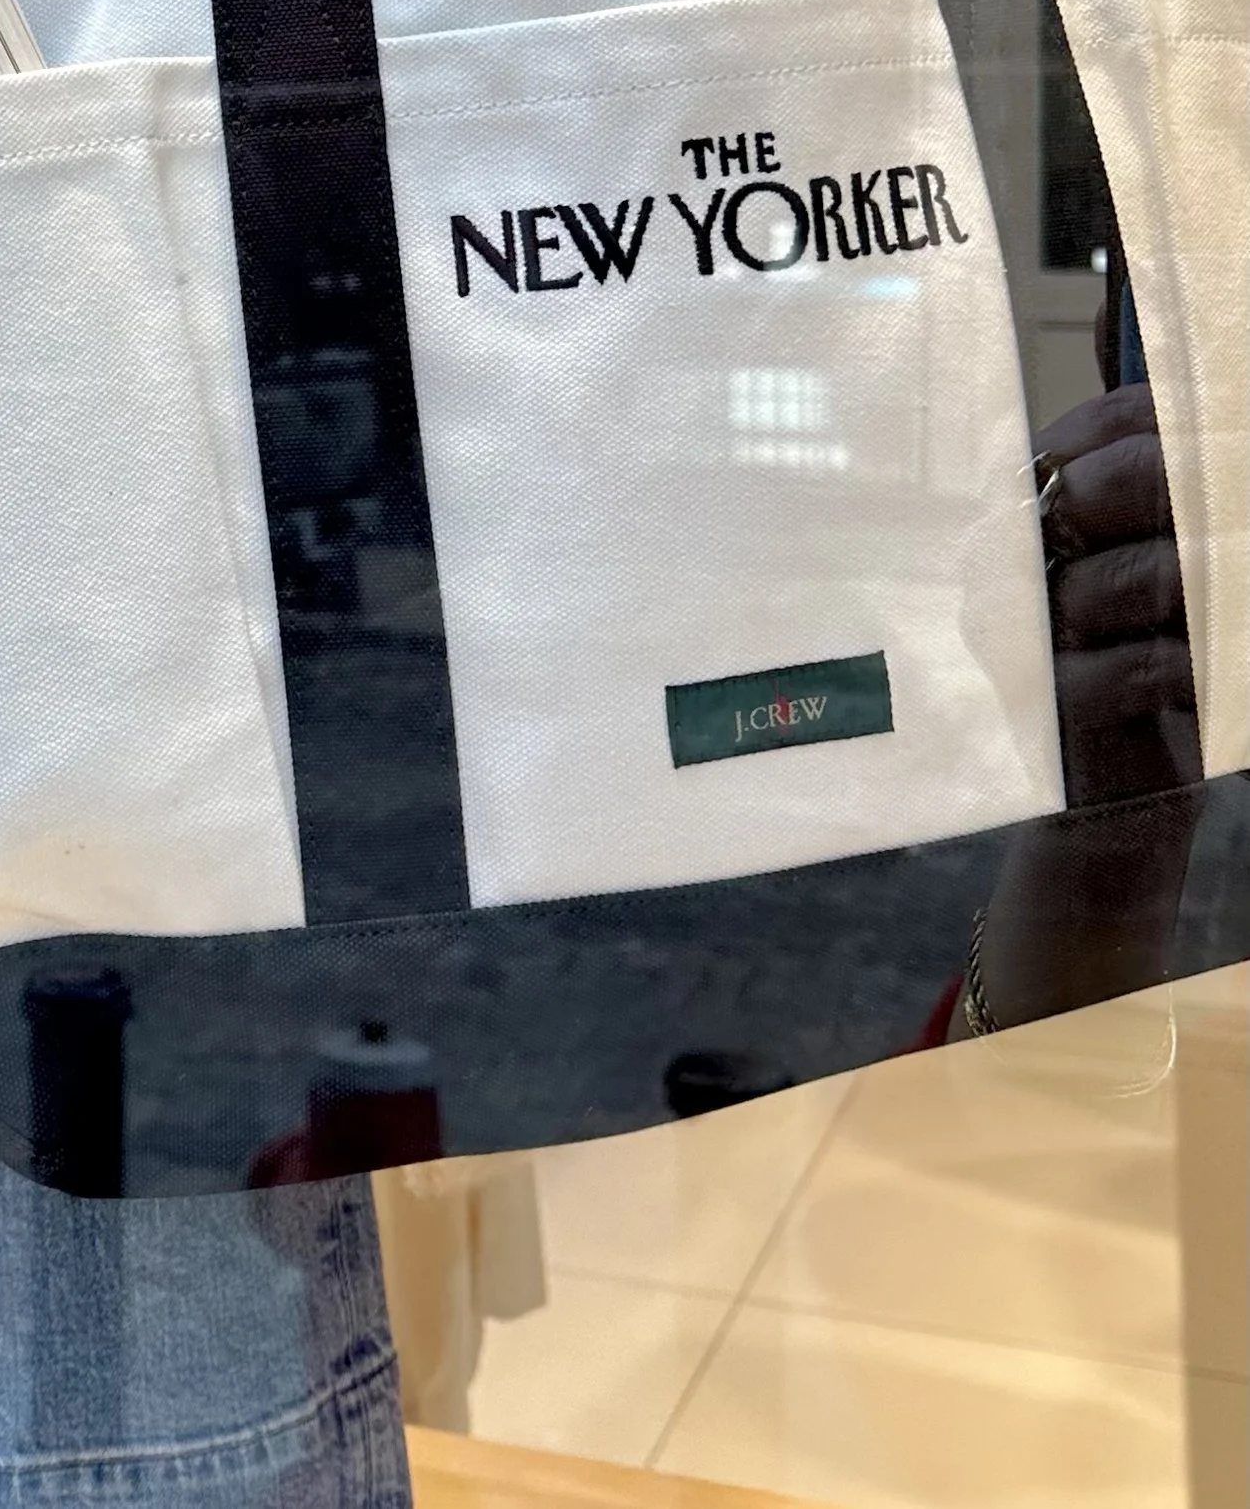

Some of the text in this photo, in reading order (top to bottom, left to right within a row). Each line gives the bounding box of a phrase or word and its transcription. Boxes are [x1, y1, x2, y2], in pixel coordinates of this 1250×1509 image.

[681, 131, 781, 180] THE
[450, 163, 969, 298] NEW YORKER
[734, 696, 828, 743] J.CREW
